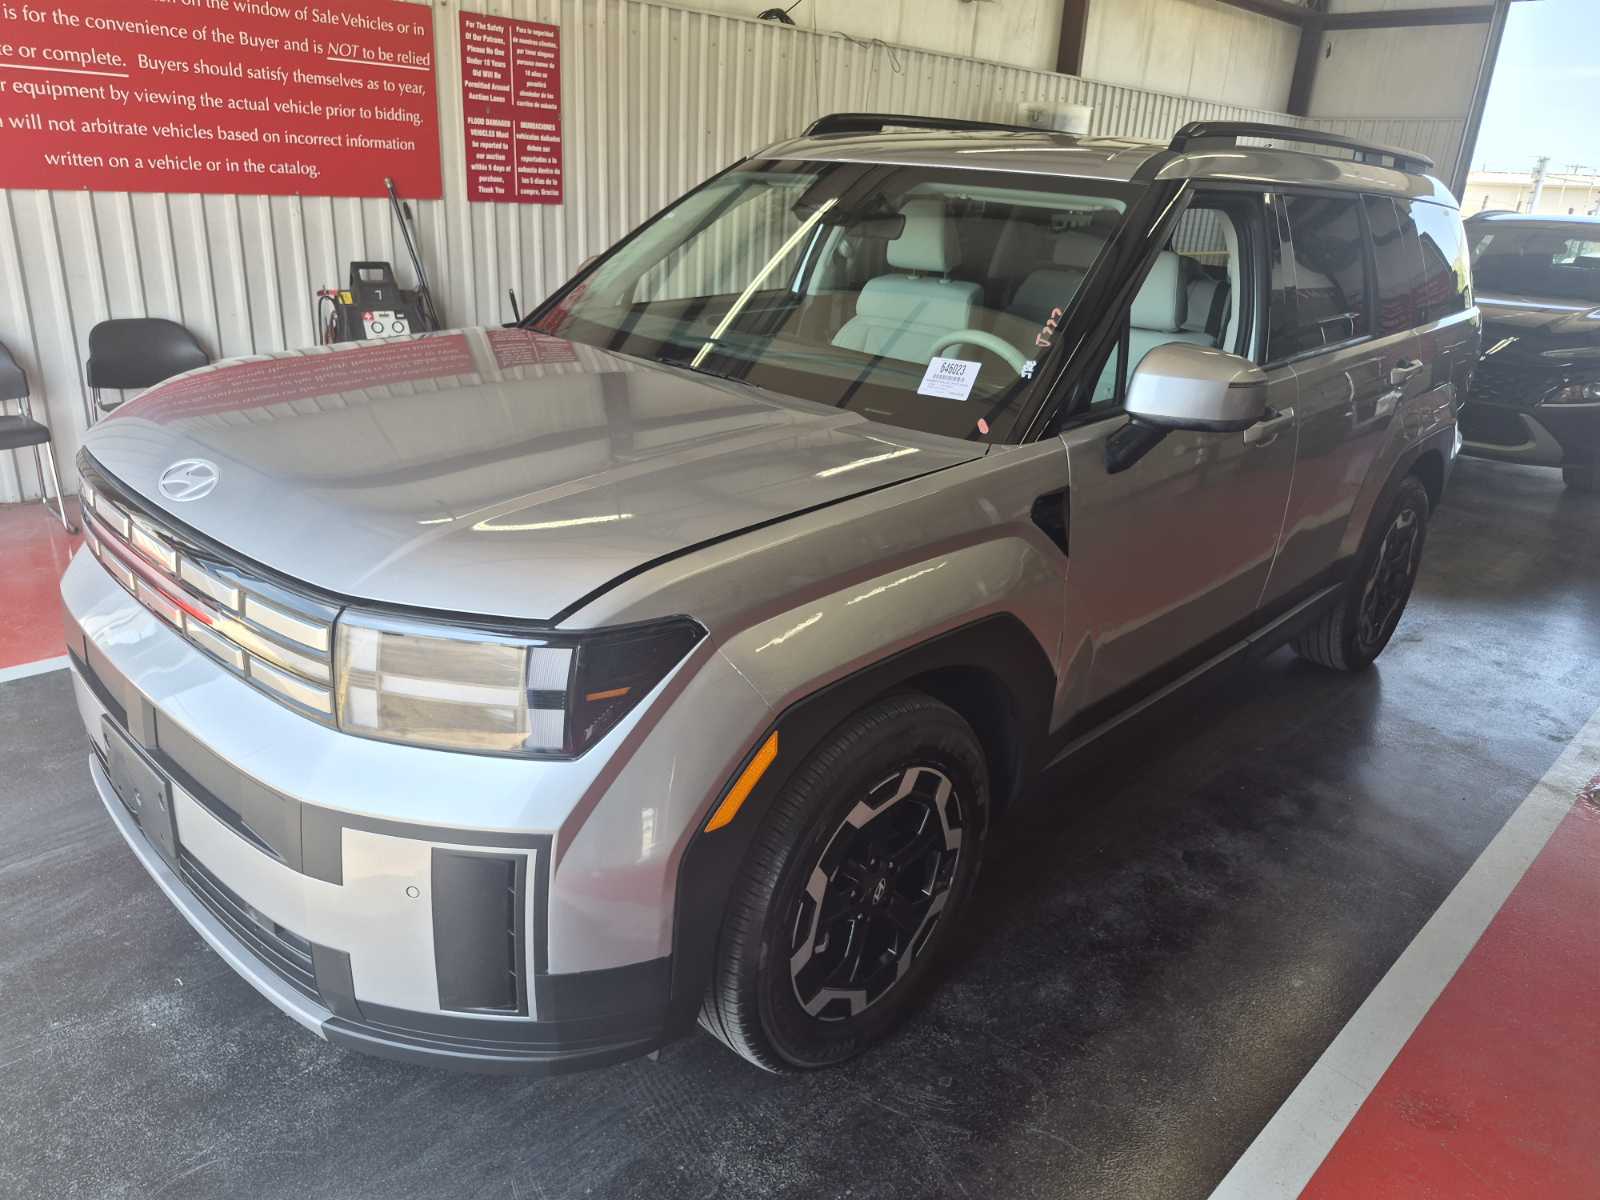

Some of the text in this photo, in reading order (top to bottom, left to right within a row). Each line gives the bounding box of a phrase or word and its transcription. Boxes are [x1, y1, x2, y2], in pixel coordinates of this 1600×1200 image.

[234, 0, 290, 18] window
[295, 7, 307, 20] of
[312, 9, 339, 24] Sale
[341, 13, 393, 31] Vehicles
[397, 24, 409, 33] or
[414, 26, 424, 35] in
[3, 3, 430, 65] is for the convenience of the Buyer and is NOT to be relied
[467, 45, 485, 54] Please
[495, 48, 504, 56] One
[467, 57, 482, 65] Under
[491, 60, 506, 68] Years
[18, 46, 36, 58] or
[43, 48, 126, 67] complete.
[138, 54, 189, 74] Buyers
[194, 59, 242, 77] should
[247, 66, 288, 85] satisfy
[293, 69, 363, 88] themselves
[367, 80, 379, 89] as
[384, 80, 395, 91] to
[399, 83, 425, 96] year,
[472, 69, 481, 77] Old
[465, 80, 490, 89] Permitted
[469, 92, 505, 102] Auction Lanes
[13, 80, 105, 100] equipment
[109, 84, 129, 105] by
[134, 88, 196, 110] viewing
[200, 92, 223, 108] the
[228, 97, 269, 111] actual
[274, 99, 321, 115] vehicle
[326, 107, 355, 119] prior
[360, 108, 371, 118] to
[375, 106, 423, 126] bidding.
[468, 117, 511, 127] FLOOD DAMAGED
[8, 114, 42, 130] will
[48, 119, 76, 131] not
[81, 117, 147, 135] arbitrate
[152, 122, 213, 139] vehicles
[217, 126, 258, 142] based
[263, 133, 280, 142] on
[285, 131, 342, 146] incorrect
[347, 135, 415, 150] information
[471, 129, 495, 137] VEHICLES
[480, 142, 502, 150] reported
[45, 152, 320, 178] written on a vehicle or in the catalog.
